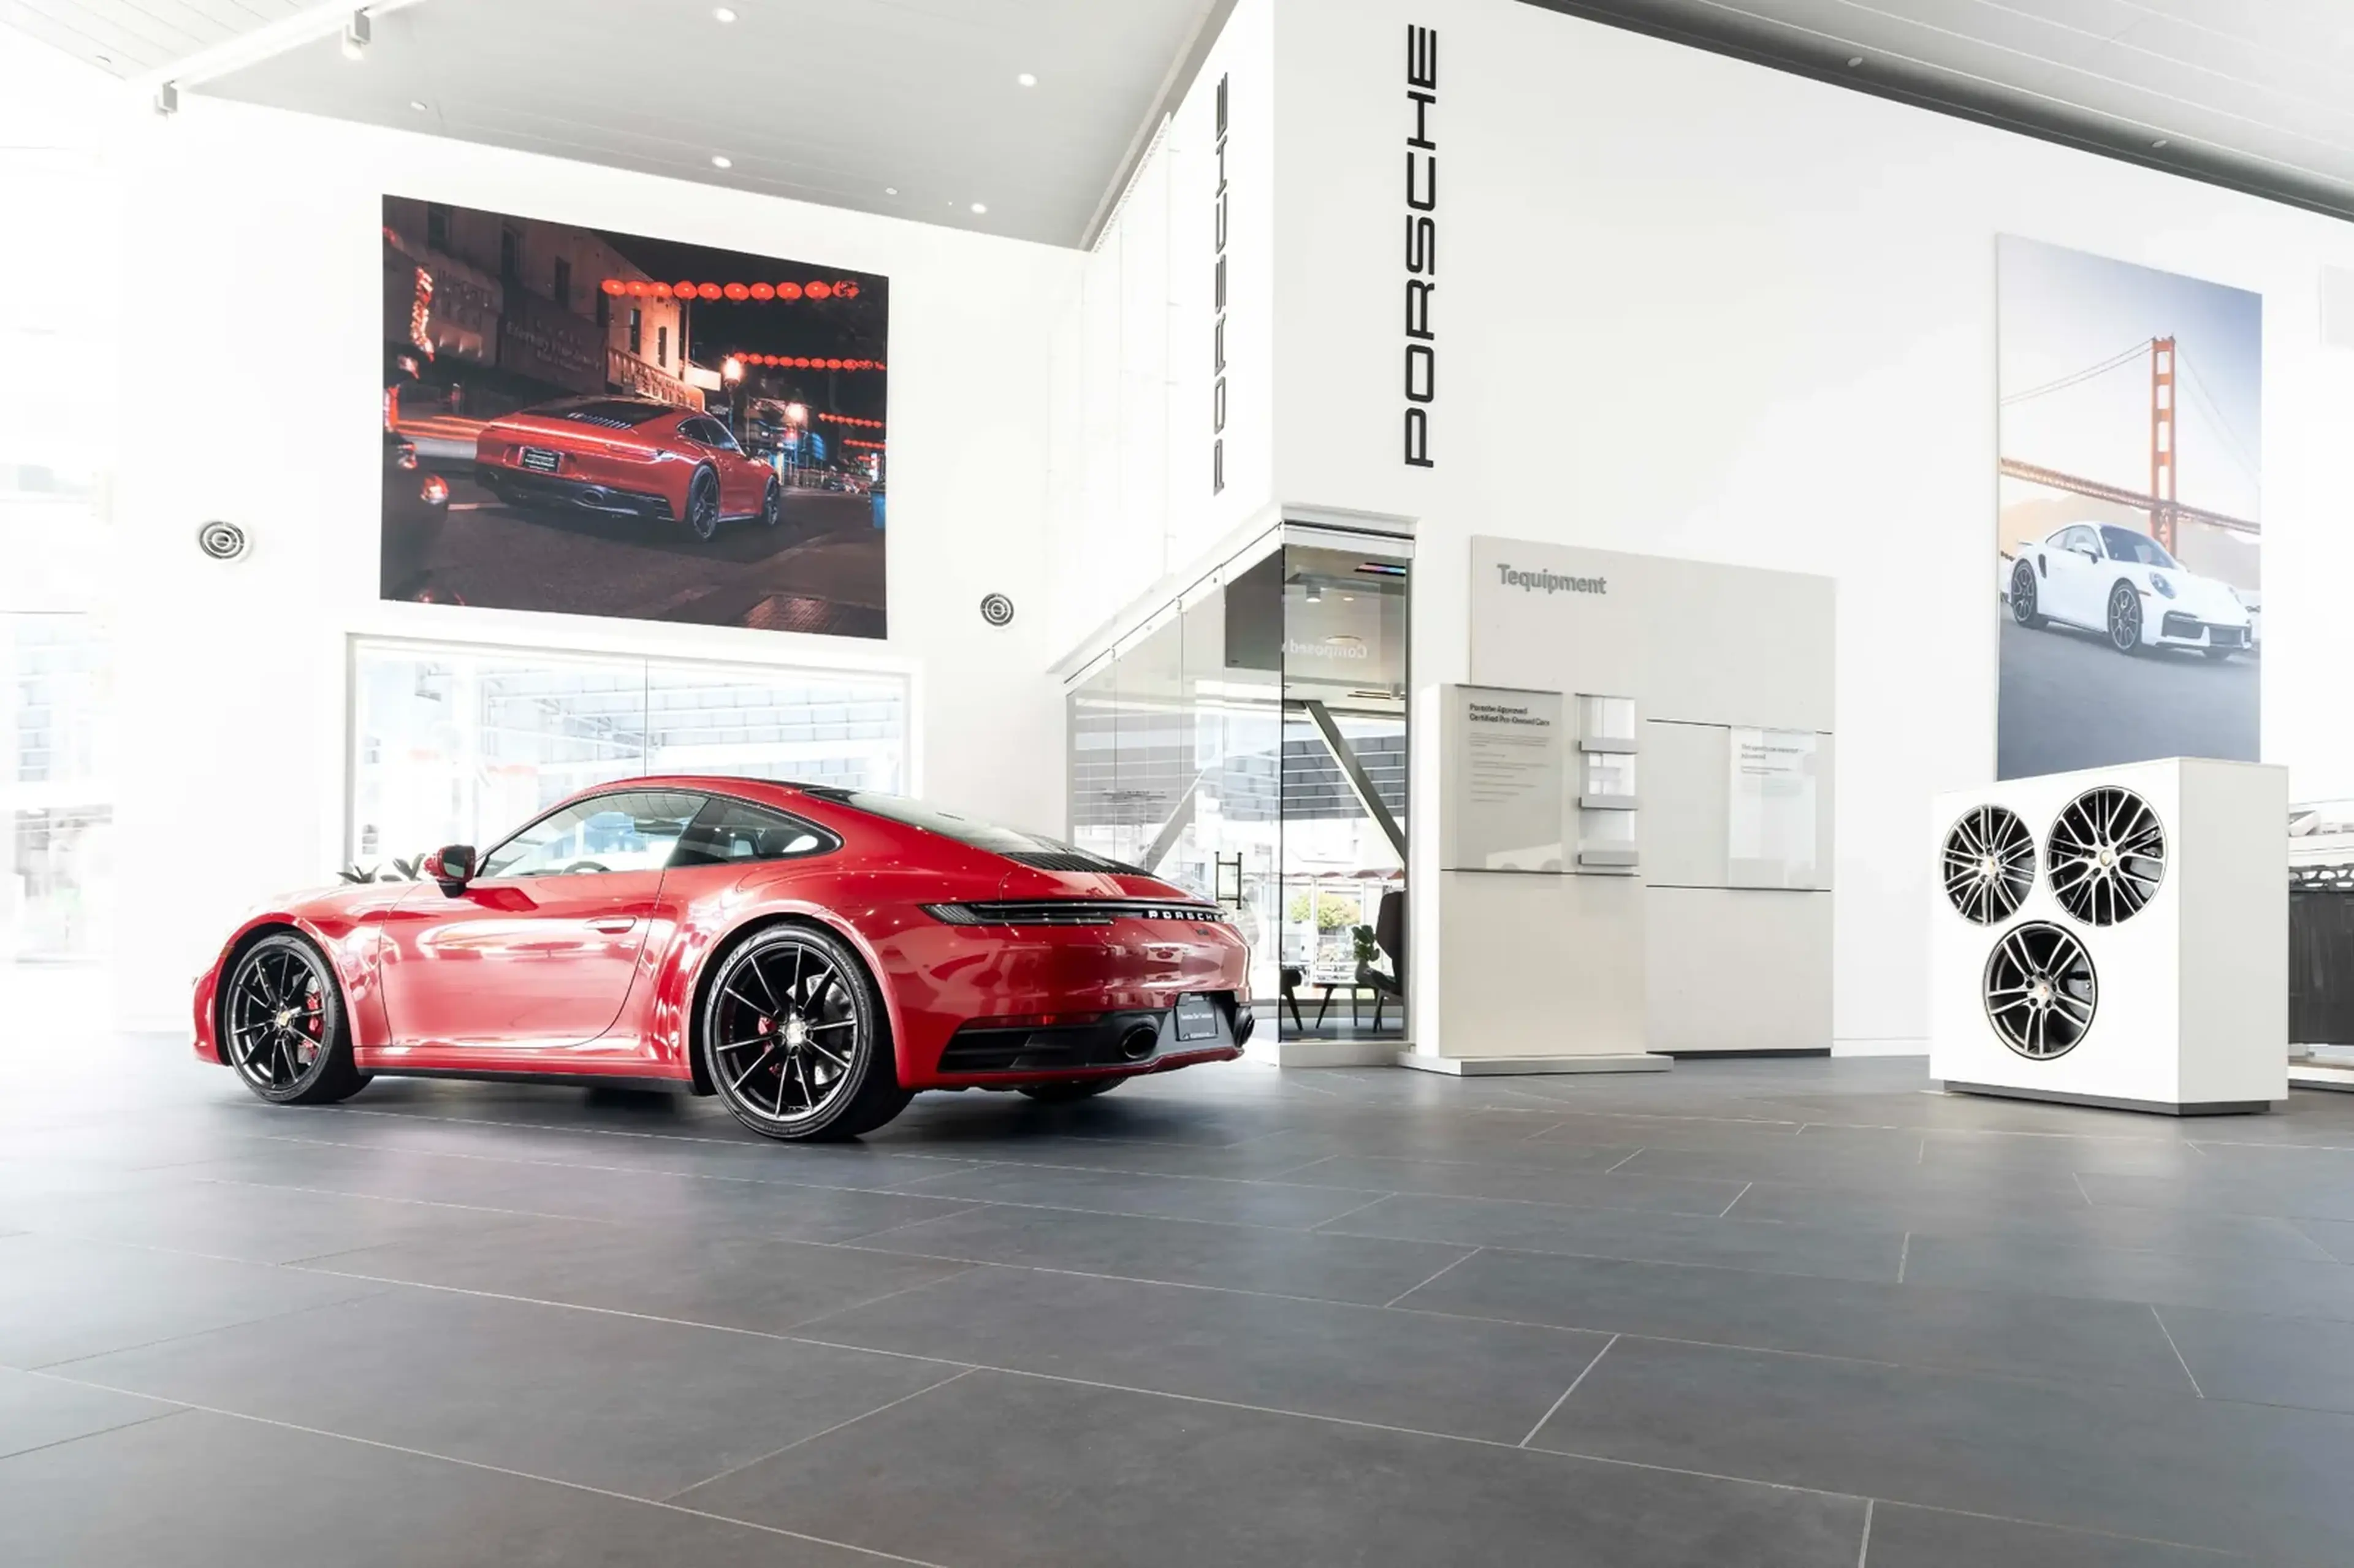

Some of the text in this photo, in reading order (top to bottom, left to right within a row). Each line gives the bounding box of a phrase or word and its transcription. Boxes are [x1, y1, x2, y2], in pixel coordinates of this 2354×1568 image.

[1213, 72, 1228, 496] PORSCHE
[1404, 24, 1437, 468] PORSCHE
[1496, 564, 1607, 595] Tequipment
[1148, 910, 1221, 921] PORSCHE
